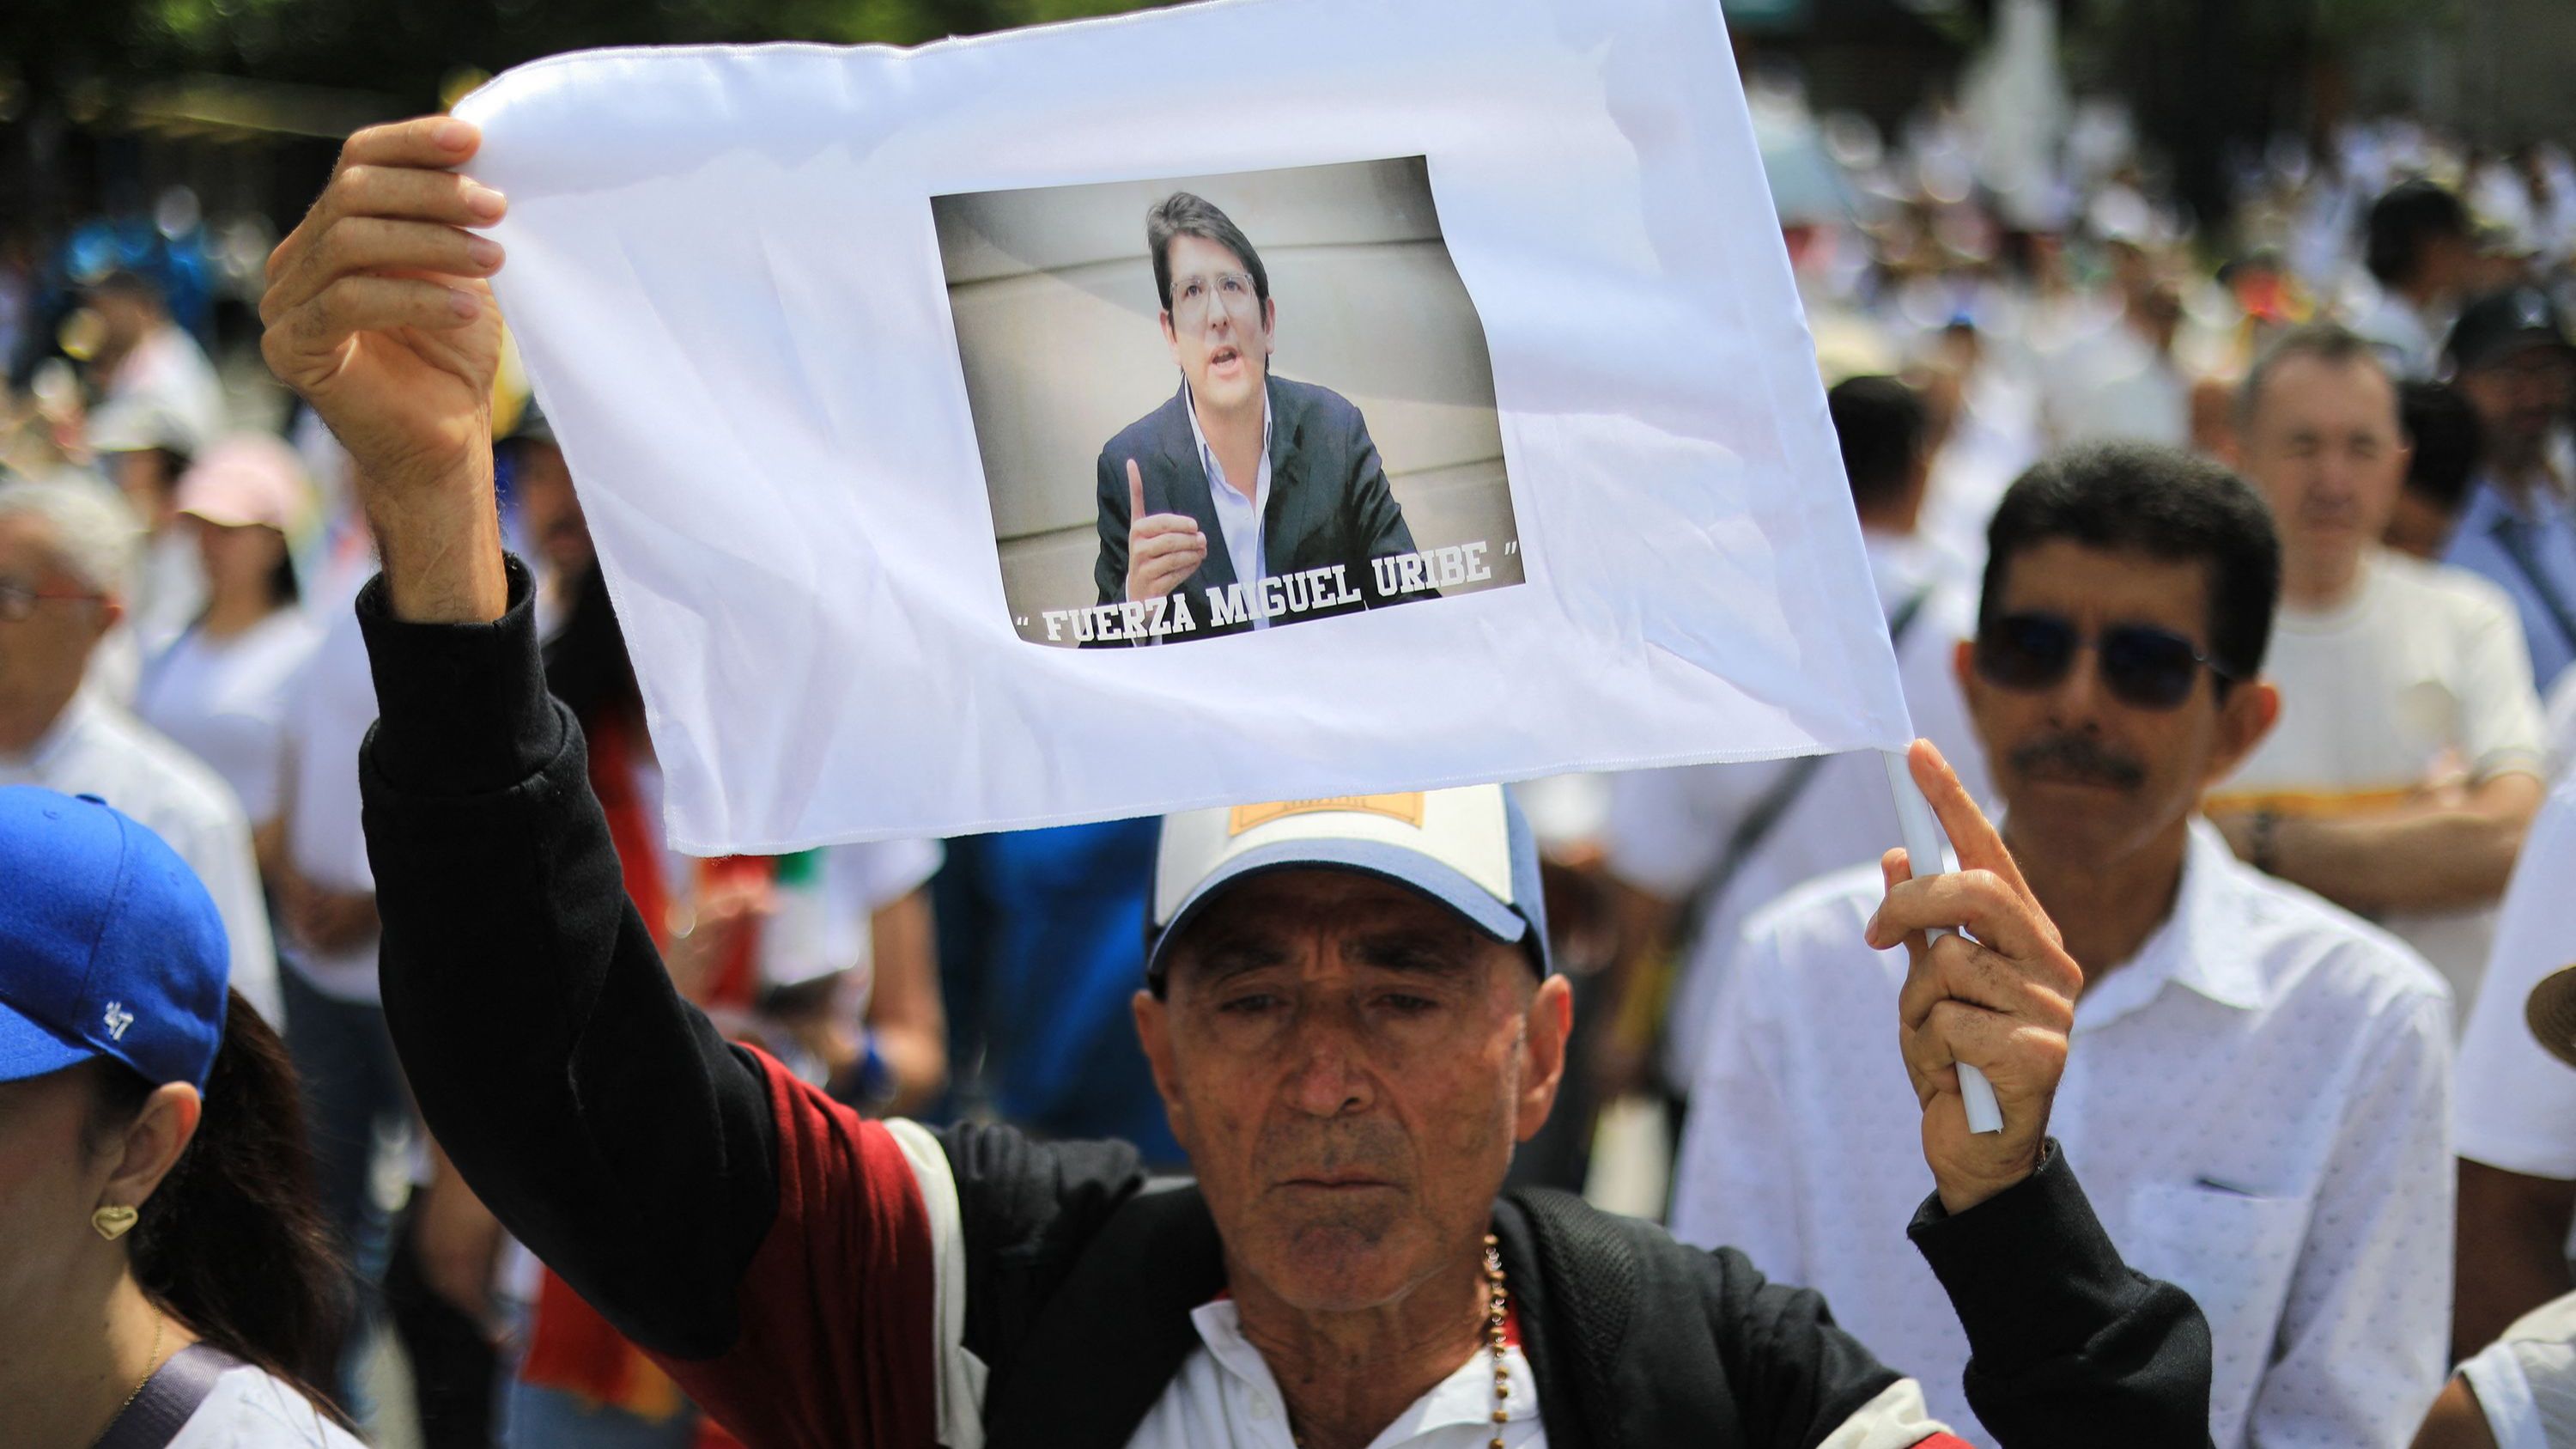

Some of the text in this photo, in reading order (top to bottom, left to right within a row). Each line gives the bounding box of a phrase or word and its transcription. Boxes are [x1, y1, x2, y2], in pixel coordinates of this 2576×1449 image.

[1042, 593, 1197, 642] FUERZA
[1205, 563, 1363, 628] MIGUEL
[1370, 540, 1492, 597] URIBE
